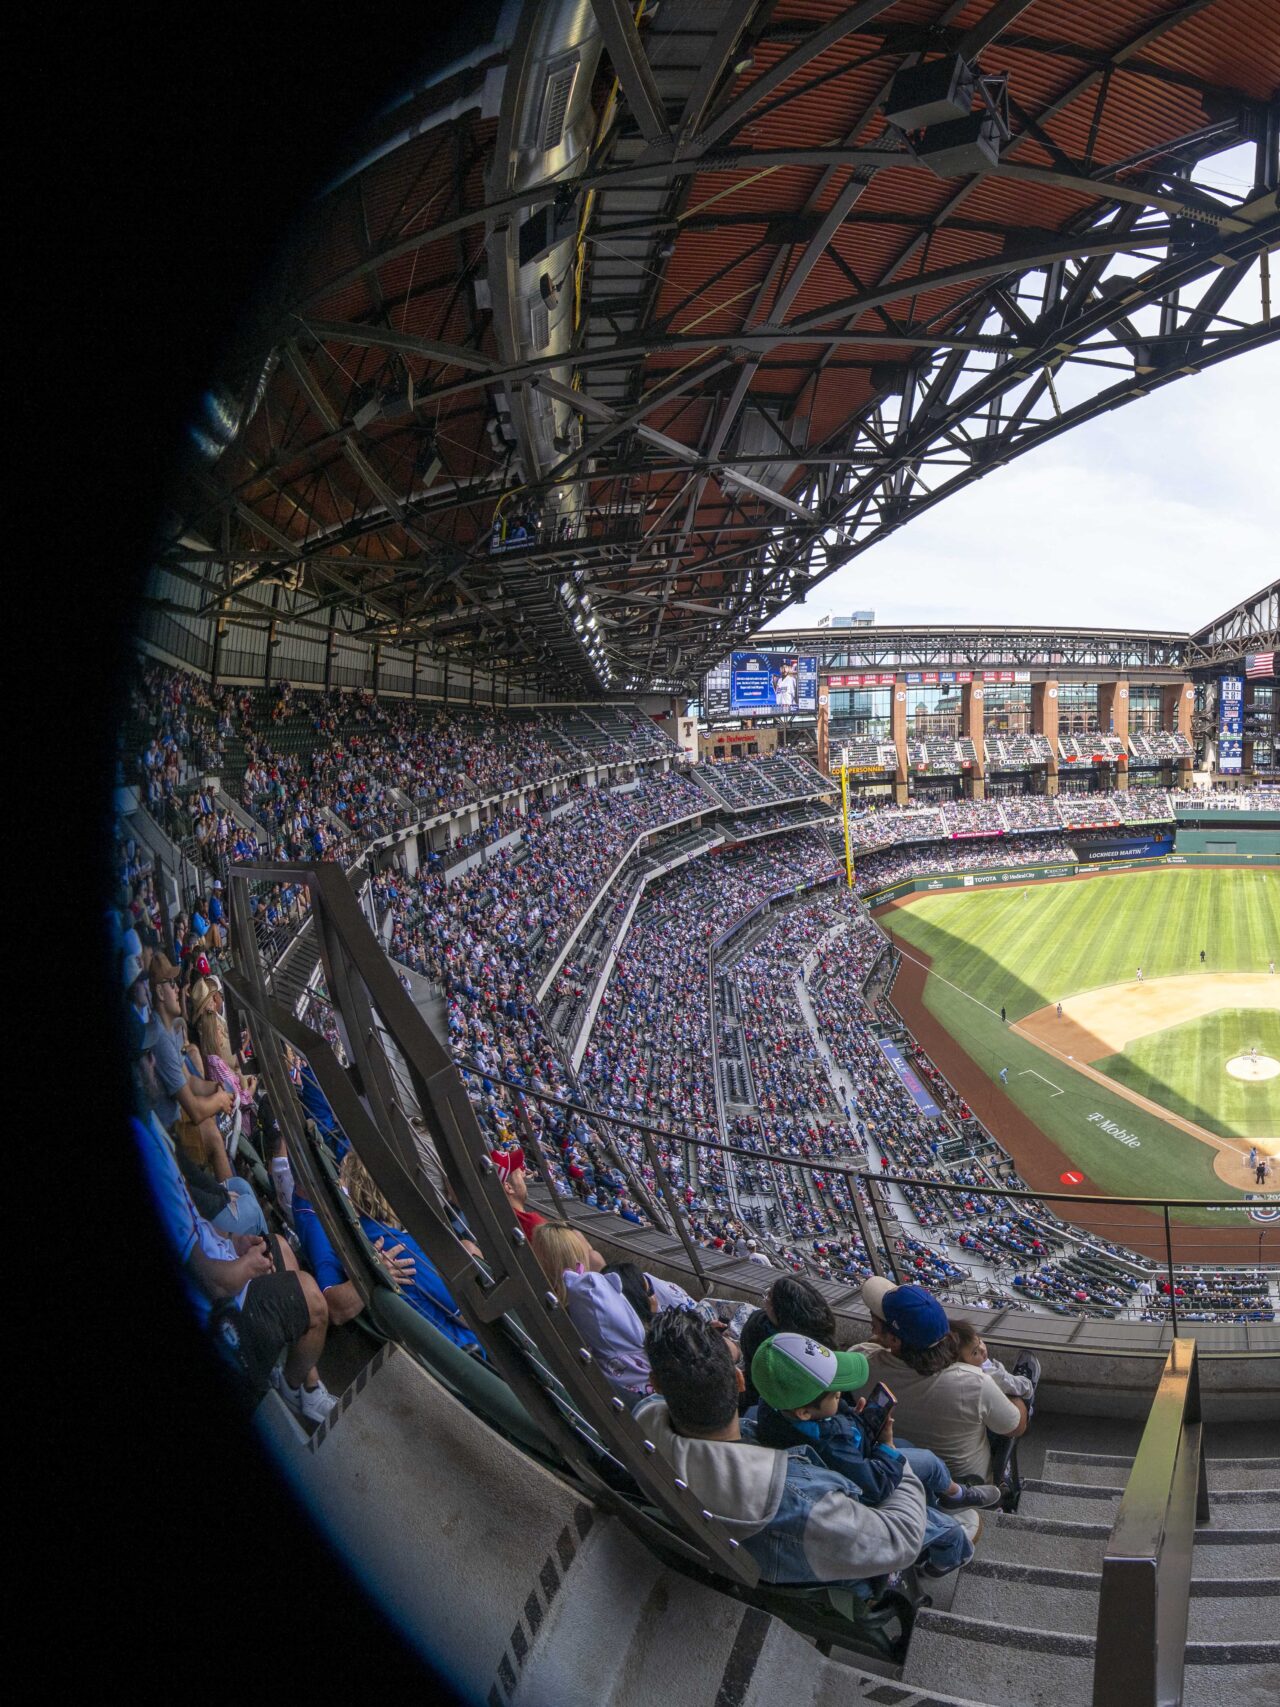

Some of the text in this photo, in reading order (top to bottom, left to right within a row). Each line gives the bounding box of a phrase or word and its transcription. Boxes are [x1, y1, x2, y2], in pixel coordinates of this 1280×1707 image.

[683, 721, 694, 737] T
[848, 765, 885, 774] PERSONNEL
[1096, 1119, 1141, 1149] Mobile
